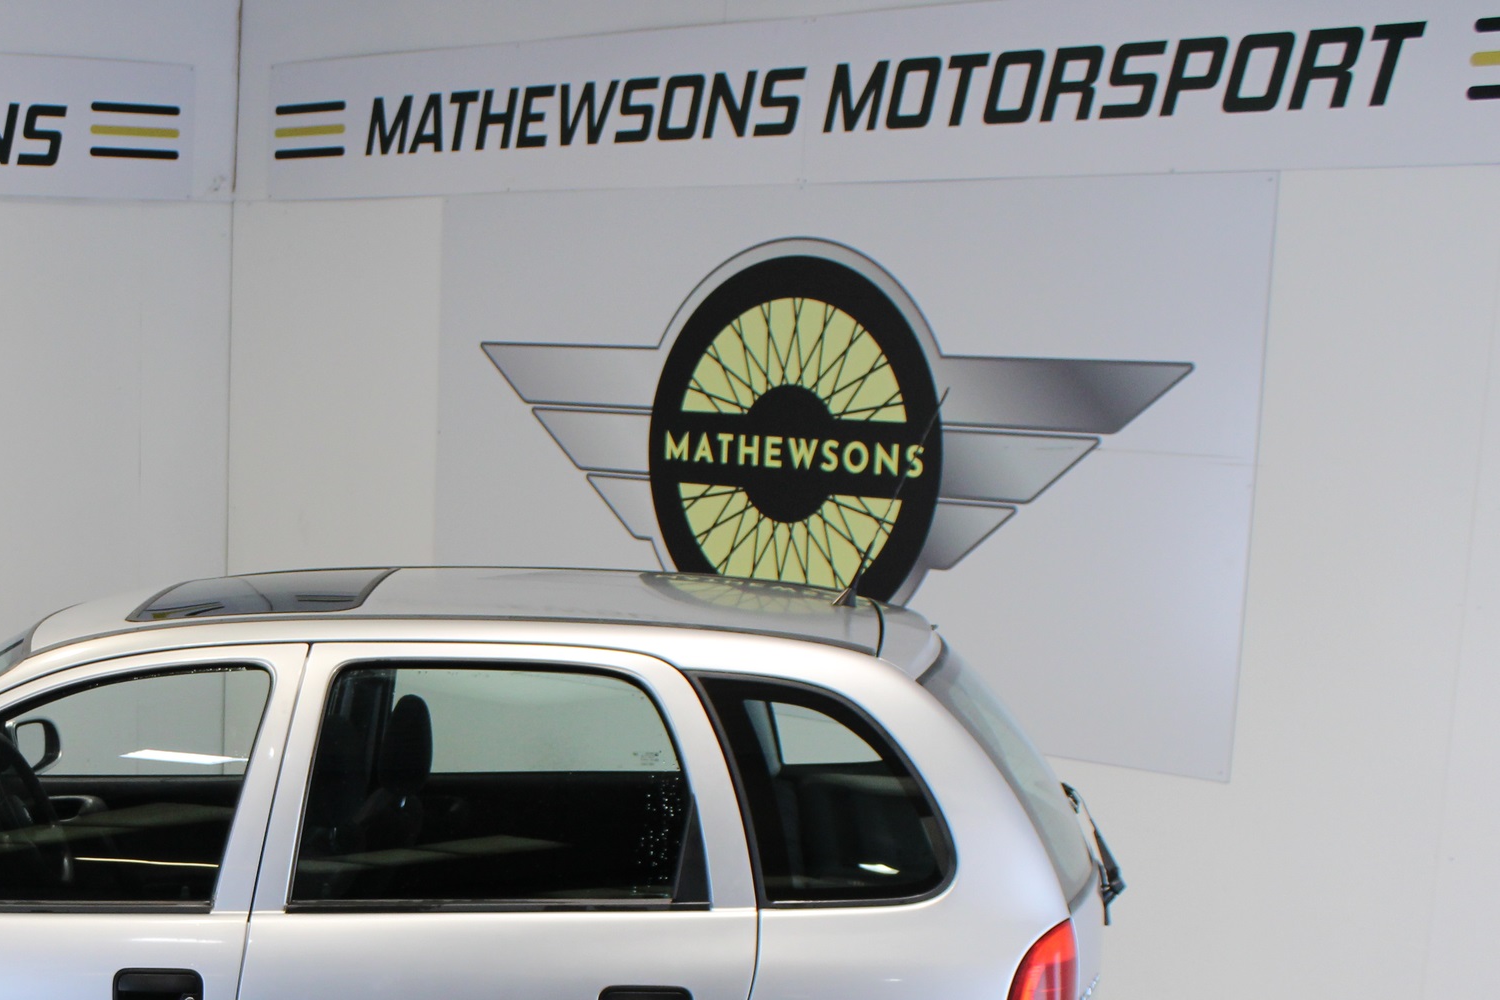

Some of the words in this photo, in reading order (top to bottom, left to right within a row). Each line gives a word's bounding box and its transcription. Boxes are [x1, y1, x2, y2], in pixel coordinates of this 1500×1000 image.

[365, 65, 808, 157] MATHEWSONS
[822, 20, 1429, 134] MOTORSPORT
[663, 429, 925, 479] MATHEWSONS
